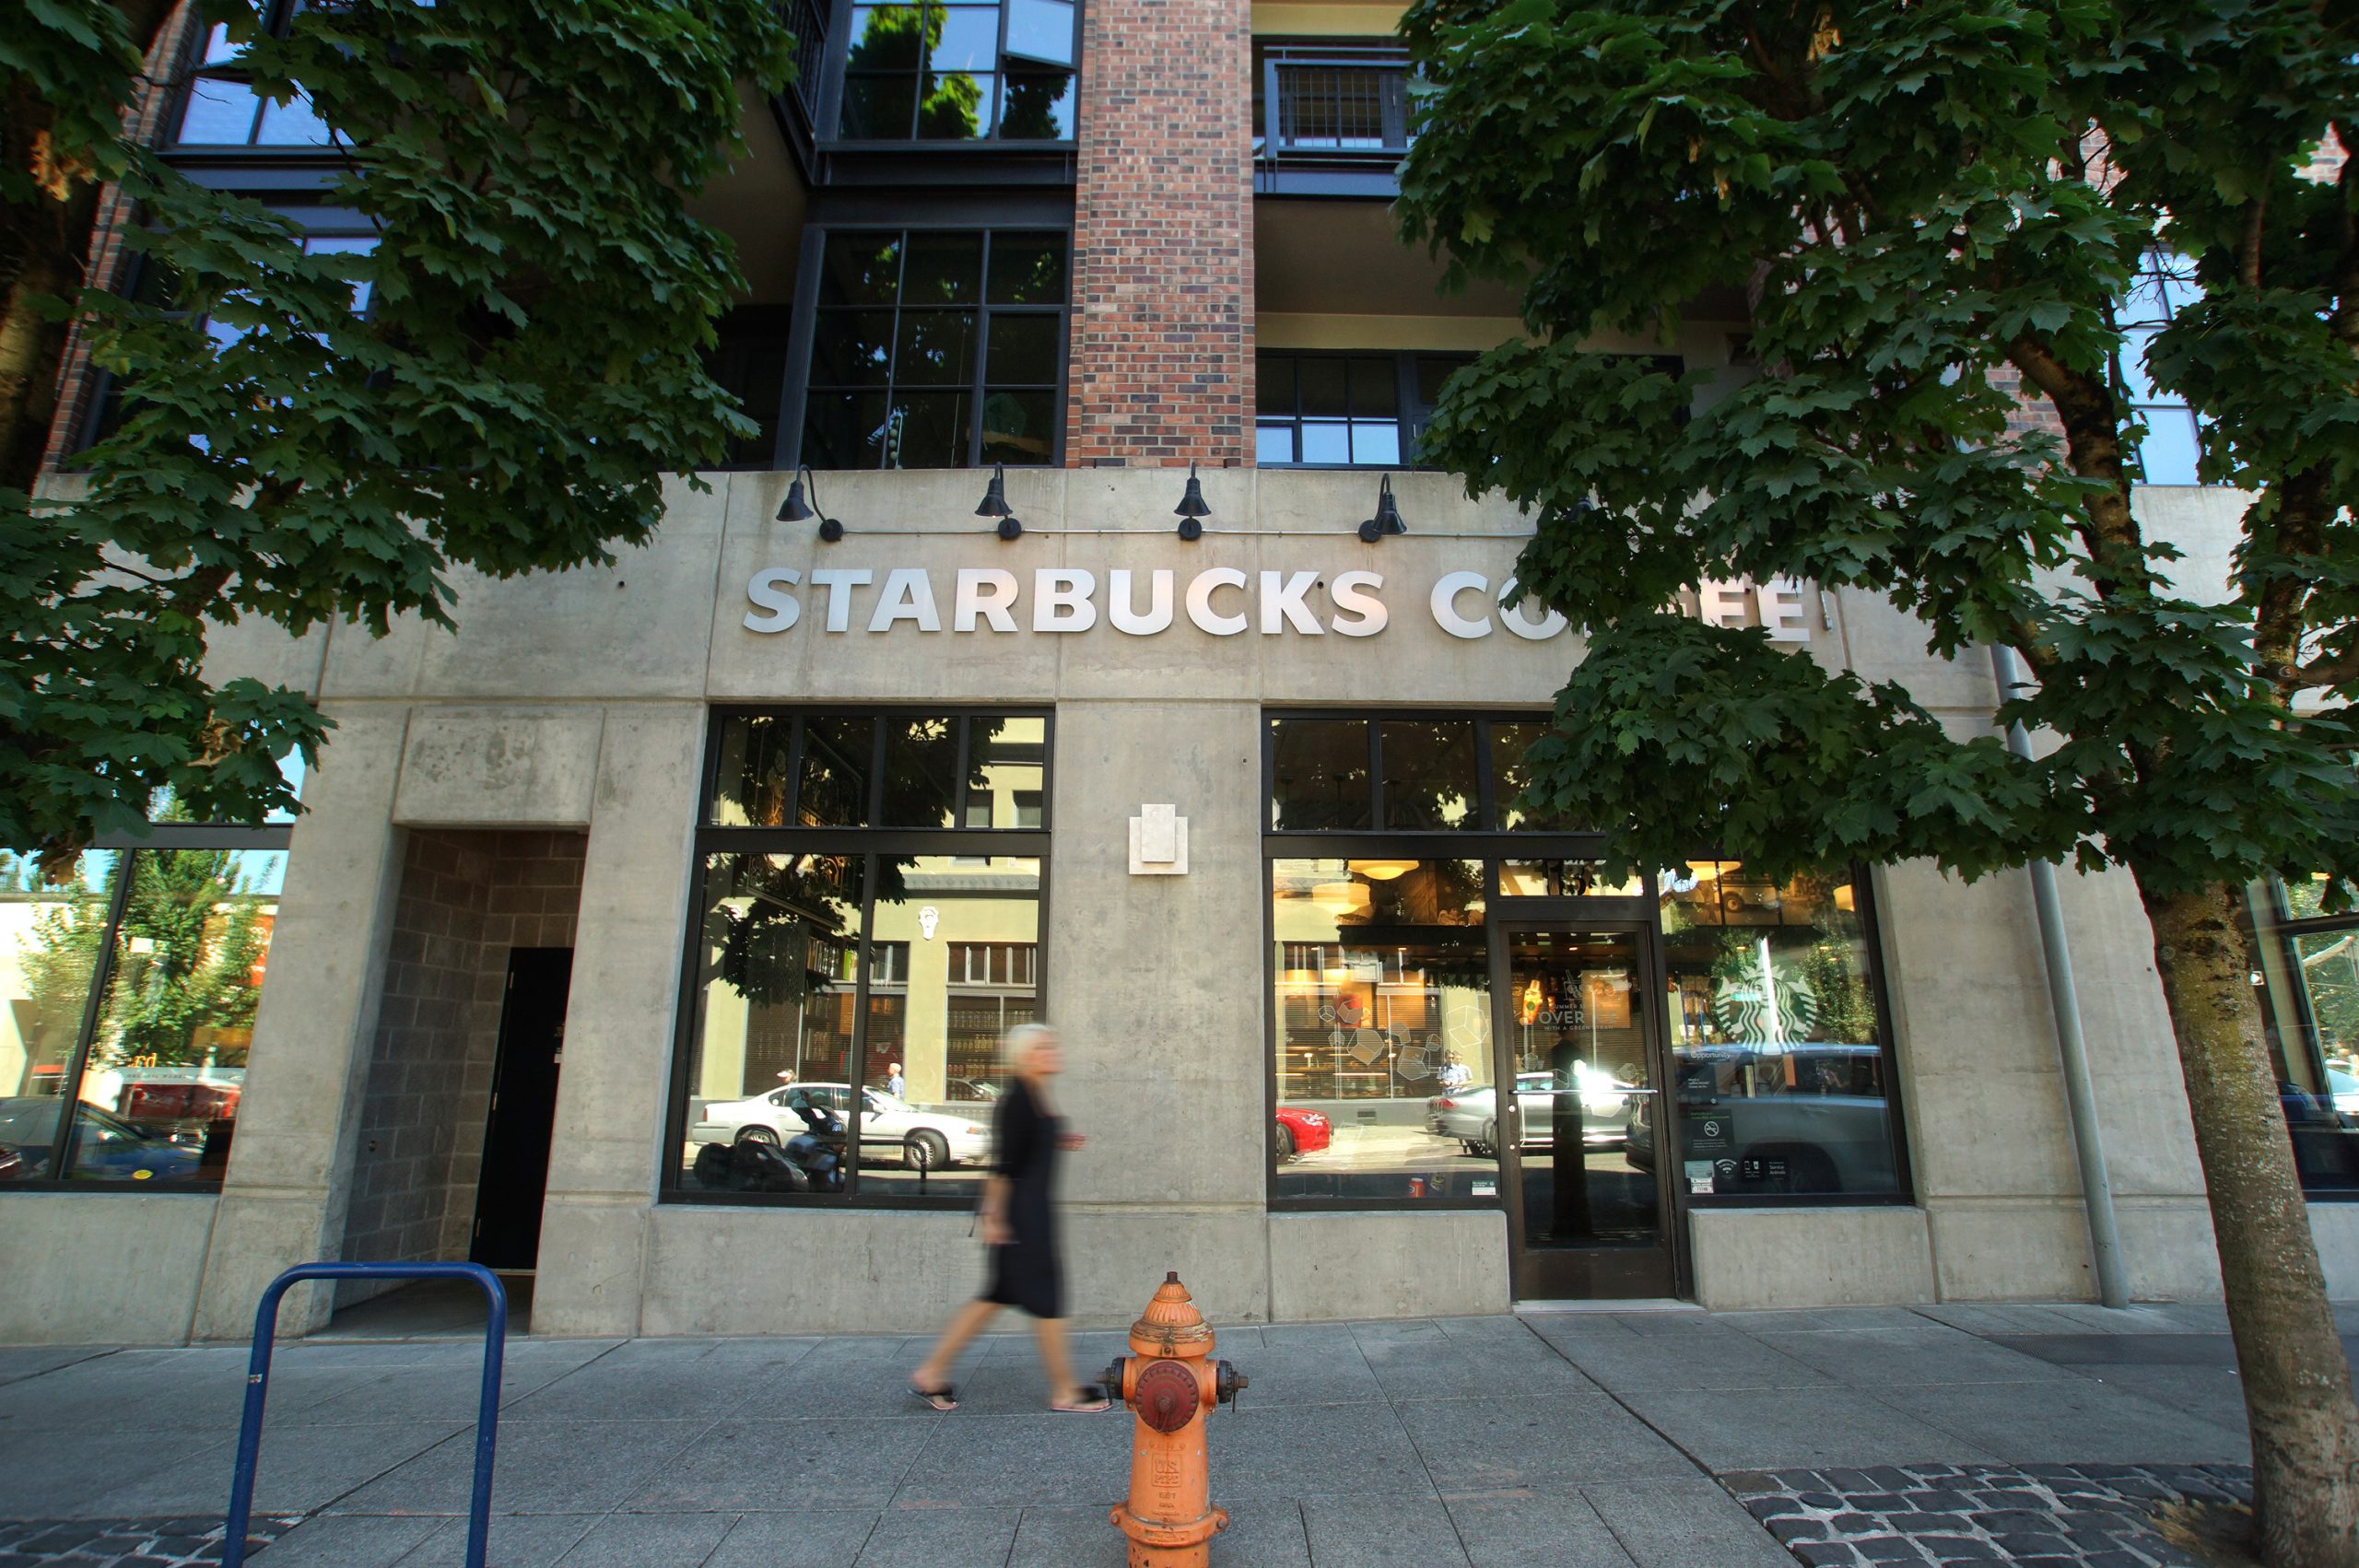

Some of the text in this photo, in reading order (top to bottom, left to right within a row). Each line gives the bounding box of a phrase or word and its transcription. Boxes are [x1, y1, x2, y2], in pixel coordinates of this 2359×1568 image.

[743, 567, 1811, 642] STARBUCKS COEE
[1538, 1011, 1585, 1024] OVER
